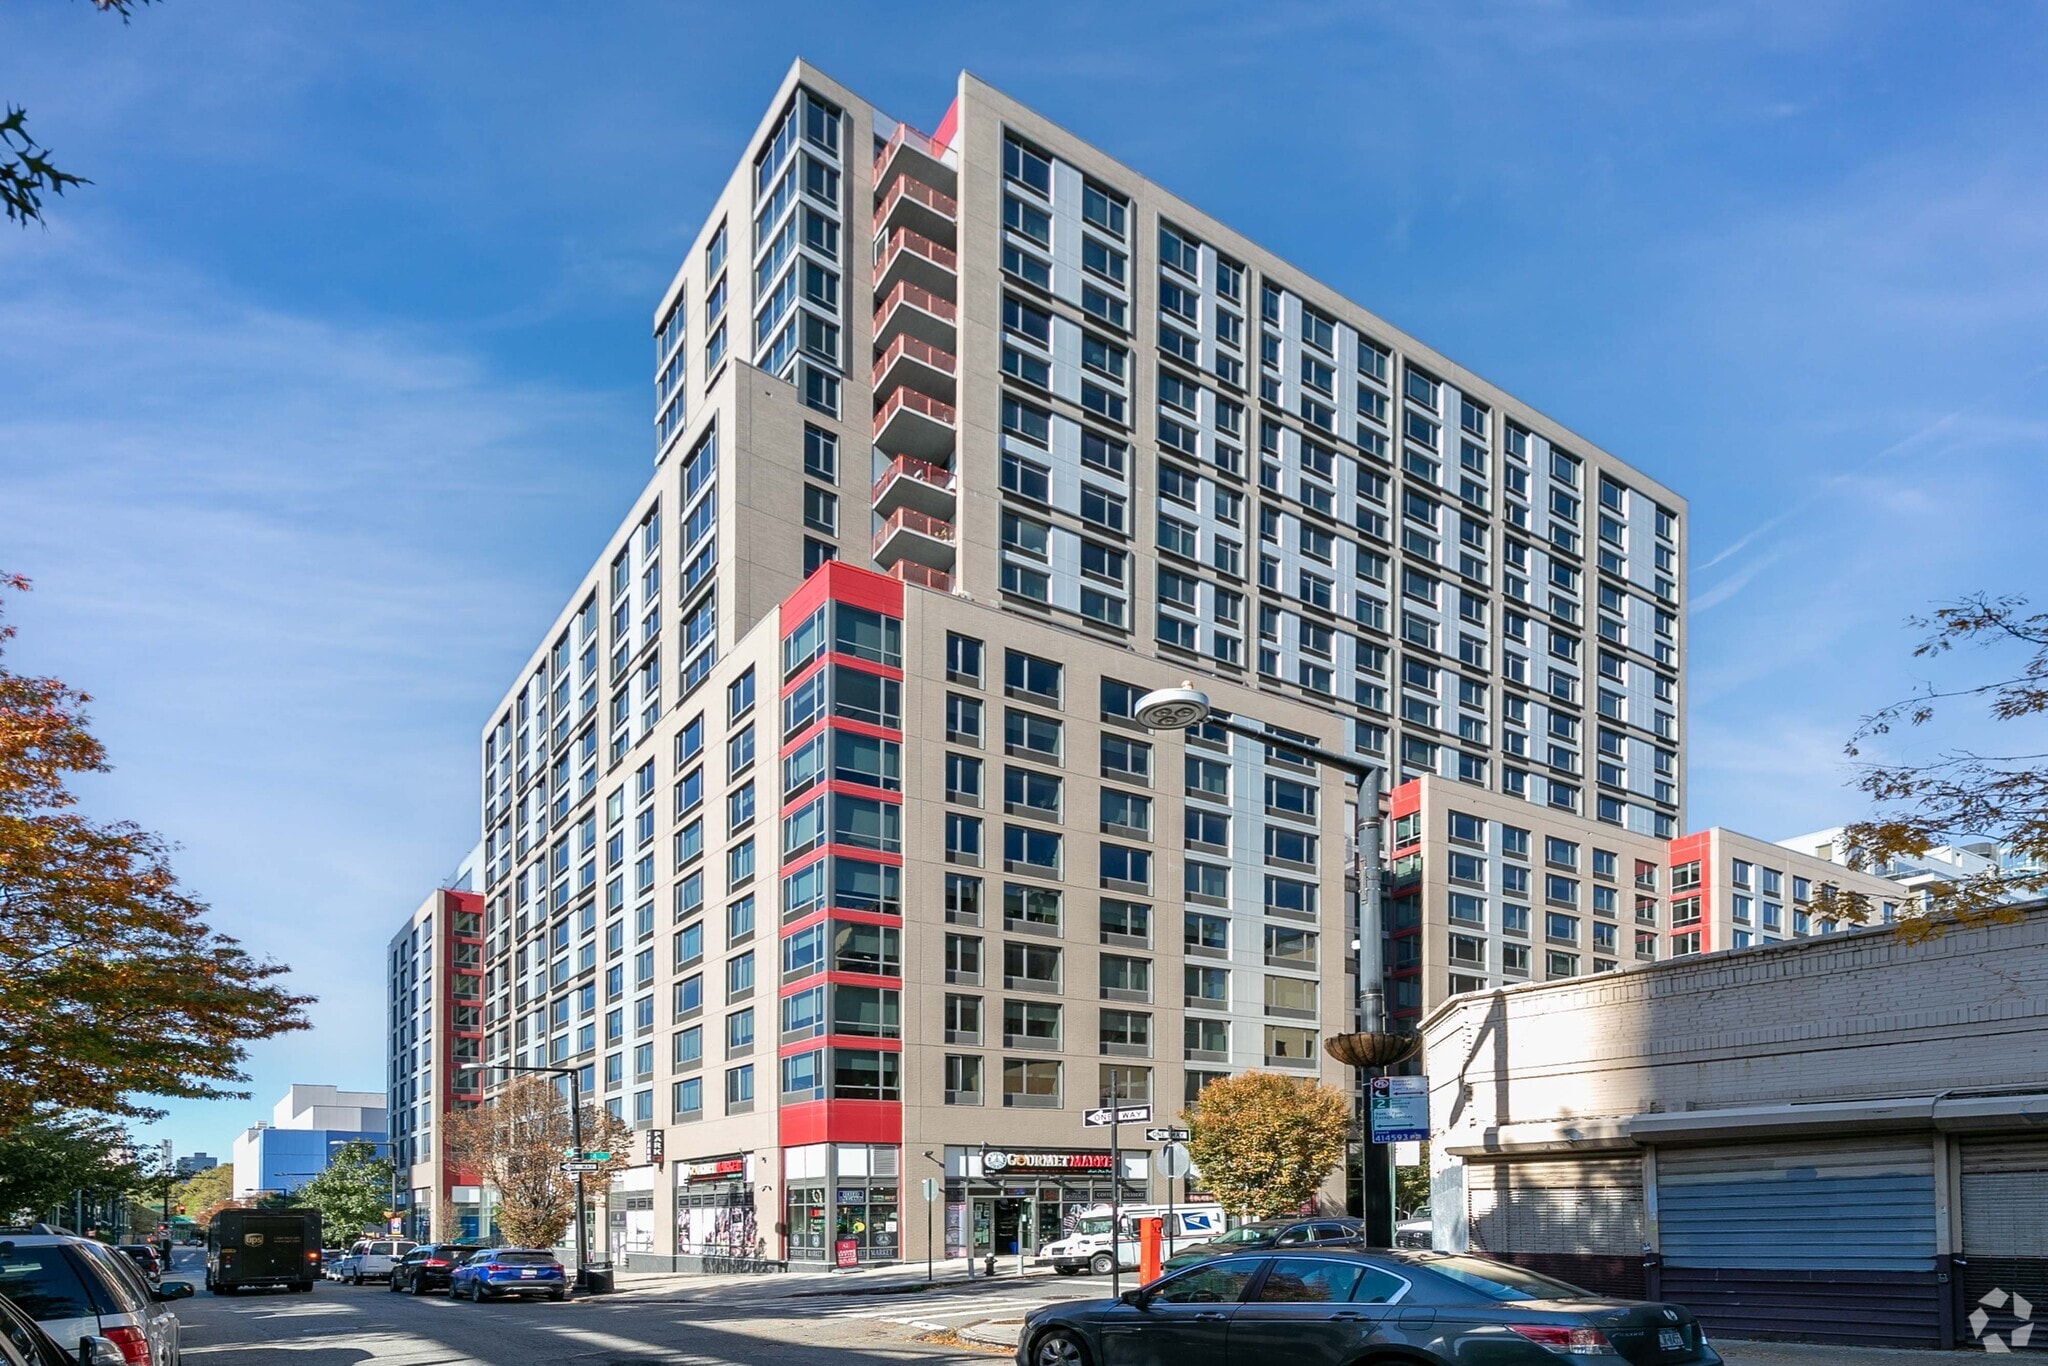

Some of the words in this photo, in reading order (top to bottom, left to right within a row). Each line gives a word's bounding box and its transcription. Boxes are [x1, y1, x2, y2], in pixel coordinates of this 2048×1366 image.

[1376, 1099, 1386, 1109] 2
[1094, 1112, 1112, 1122] ONE
[1121, 1110, 1142, 1119] WAY
[653, 1131, 662, 1155] PARK
[1375, 1133, 1409, 1142] 414593
[1007, 1153, 1069, 1167] GOURMET
[1069, 1154, 1119, 1168] MARKE
[246, 1236, 262, 1245] ups
